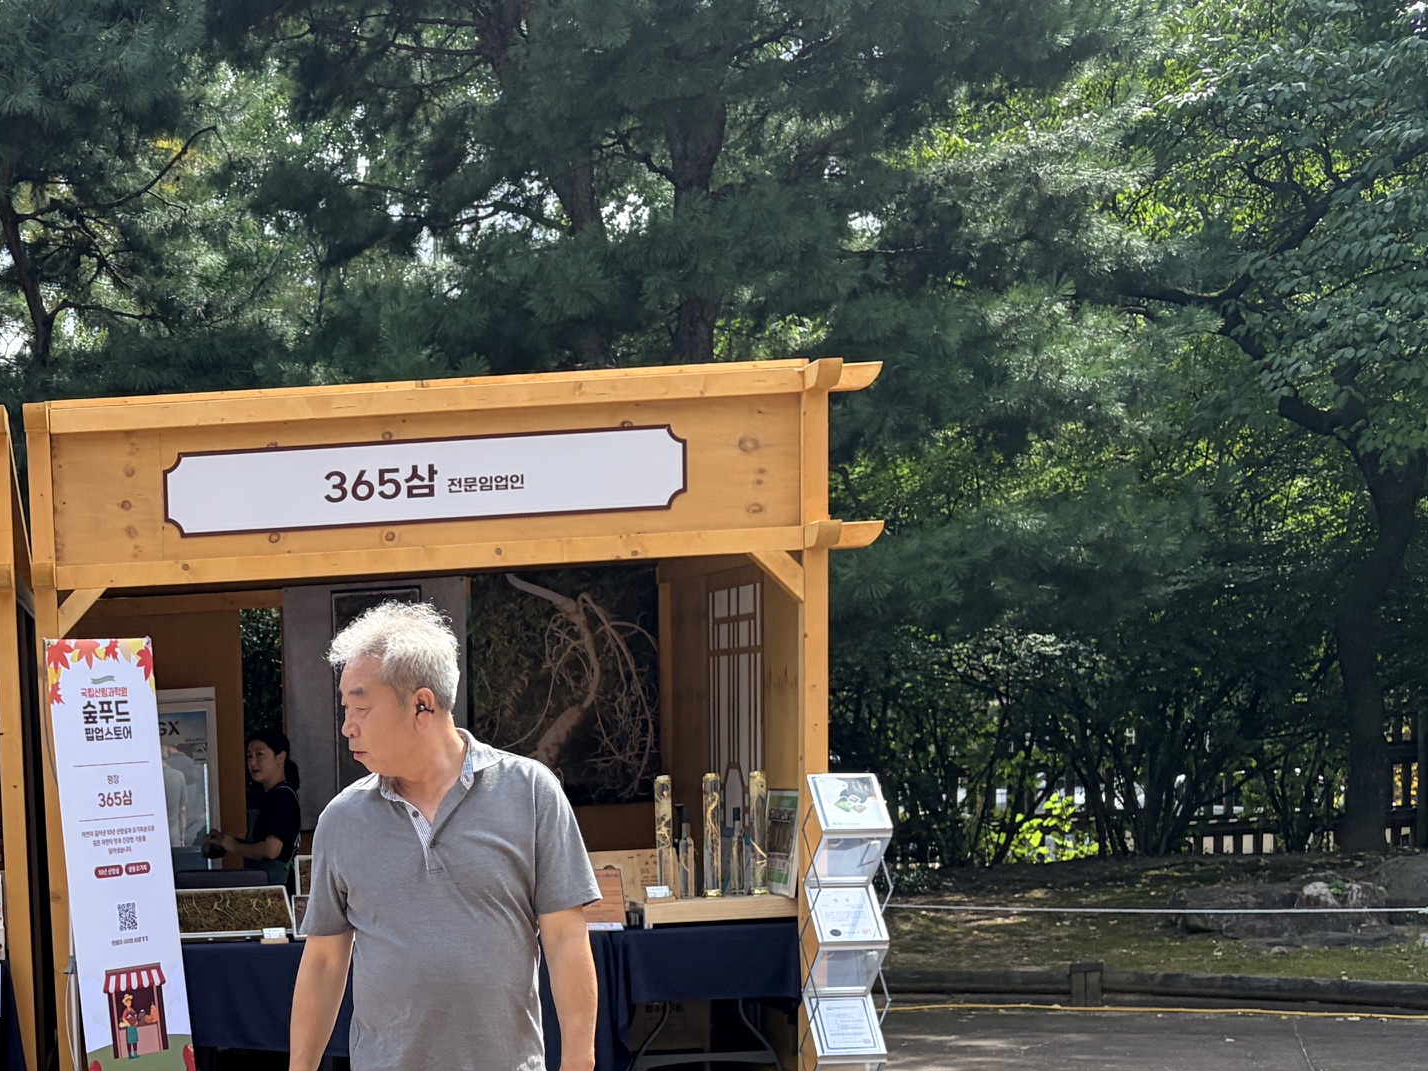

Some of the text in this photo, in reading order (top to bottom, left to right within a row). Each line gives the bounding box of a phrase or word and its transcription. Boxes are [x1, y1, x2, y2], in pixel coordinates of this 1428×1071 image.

[324, 464, 524, 503] 365삼 전문임업인
[81, 687, 128, 698] 국립산림과학원
[82, 700, 131, 724] 숲푸드
[85, 726, 132, 742] 팝업스토어
[98, 790, 133, 808] 365삼
